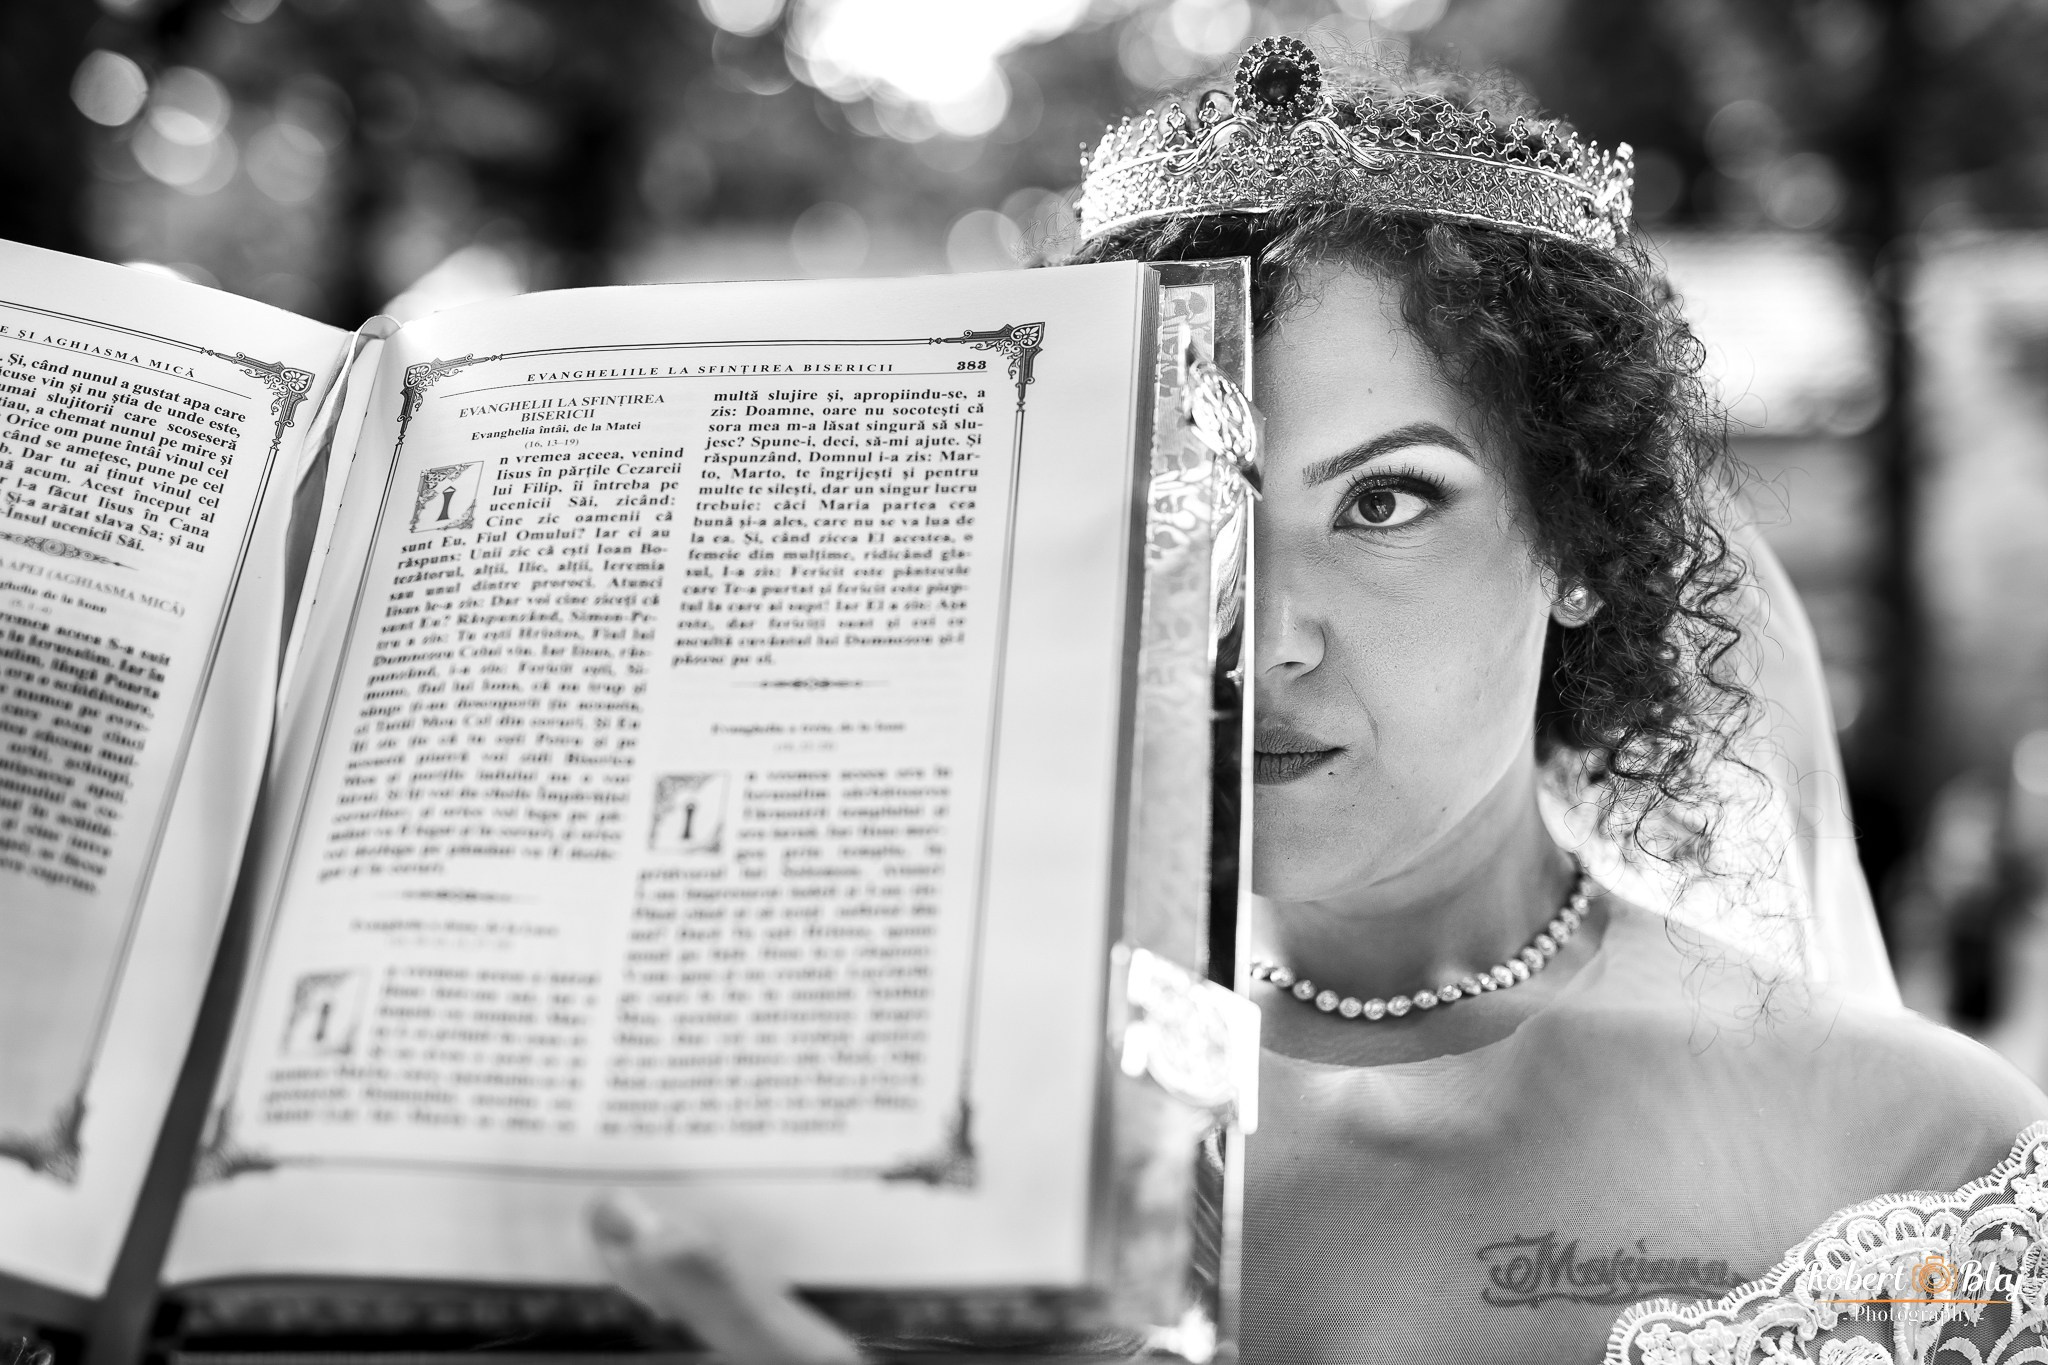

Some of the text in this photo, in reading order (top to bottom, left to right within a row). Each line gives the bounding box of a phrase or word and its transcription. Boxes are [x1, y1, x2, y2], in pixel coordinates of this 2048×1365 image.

[43, 335, 139, 363] AGHIASMA
[149, 359, 194, 378] MICĂ
[956, 360, 987, 371] 383
[527, 367, 658, 382] EVANGHELIILE
[668, 367, 688, 375] LA
[804, 364, 892, 372] BISERICII
[31, 359, 69, 375] când
[72, 369, 118, 386] nunul
[120, 381, 129, 389] a
[132, 384, 181, 402] gustat
[183, 397, 210, 412] apa
[214, 406, 246, 423] care
[714, 390, 758, 401] multă
[768, 389, 818, 403] slujire
[977, 390, 985, 398] a
[42, 377, 64, 389] vin
[87, 388, 107, 399] nu
[144, 400, 162, 413] de
[167, 408, 205, 425] unde
[459, 399, 553, 418] EVANGHELII
[557, 398, 577, 407] LA
[822, 407, 857, 416] oare
[865, 407, 884, 415] nu
[967, 403, 984, 414] că
[46, 393, 114, 416] slujitorii
[124, 412, 157, 427] care
[167, 423, 237, 451] scoseseră
[521, 409, 595, 422] BISERICII
[35, 407, 44, 415] a
[49, 408, 106, 429] chemat
[110, 423, 156, 442] nunul
[158, 436, 178, 448] pe
[181, 443, 217, 460] mire
[471, 426, 535, 441] Evanghelia
[573, 424, 588, 432] de
[591, 423, 602, 431] la
[606, 421, 641, 431] Matei
[708, 424, 741, 432] sora
[748, 423, 780, 431] mea
[787, 423, 816, 431] m-a
[823, 420, 859, 431] lăsat
[866, 420, 925, 434] singură
[932, 420, 947, 430] să
[6, 414, 229, 480] Orice om pune întâi vinul cel
[704, 436, 745, 451] jesc?
[866, 435, 909, 447] să-mi
[3, 429, 41, 445] când
[45, 440, 61, 449] se
[136, 462, 175, 479] pune
[178, 474, 198, 486] pe
[203, 481, 224, 494] cel
[516, 453, 571, 463] vremea
[632, 447, 684, 459] venind
[809, 451, 872, 462] Domnul
[879, 451, 898, 462] i-a
[21, 447, 53, 462] Dar
[60, 457, 76, 469] tu
[84, 463, 100, 474] ai
[153, 481, 192, 500] vinul
[198, 496, 220, 509] cel
[497, 469, 531, 480] Iisus
[538, 466, 552, 478] în
[616, 462, 681, 475] Cezareii
[796, 469, 810, 478] te
[925, 468, 978, 481] pentru
[493, 484, 513, 496] lui
[573, 480, 583, 491] îi
[593, 479, 649, 491] întreba
[660, 481, 679, 493] pe
[699, 484, 744, 495] multe
[749, 485, 763, 494] te
[822, 483, 848, 494] dar
[854, 486, 874, 494] un
[880, 484, 928, 496] singur
[935, 483, 977, 494] lucru
[17, 477, 37, 491] l-a
[48, 485, 88, 503] făcut
[98, 496, 133, 515] Iisus
[144, 508, 158, 522] în
[169, 517, 209, 538] Cana
[81, 478, 124, 496] Acest
[133, 489, 191, 516] început
[200, 512, 215, 523] al
[489, 497, 551, 512] ucenicii
[41, 502, 90, 520] arătat
[95, 513, 134, 532] slava
[139, 524, 164, 541] Sa;
[186, 541, 205, 553] au
[486, 511, 673, 527] Cine zic oamenii că
[51, 520, 113, 542] ucenicii
